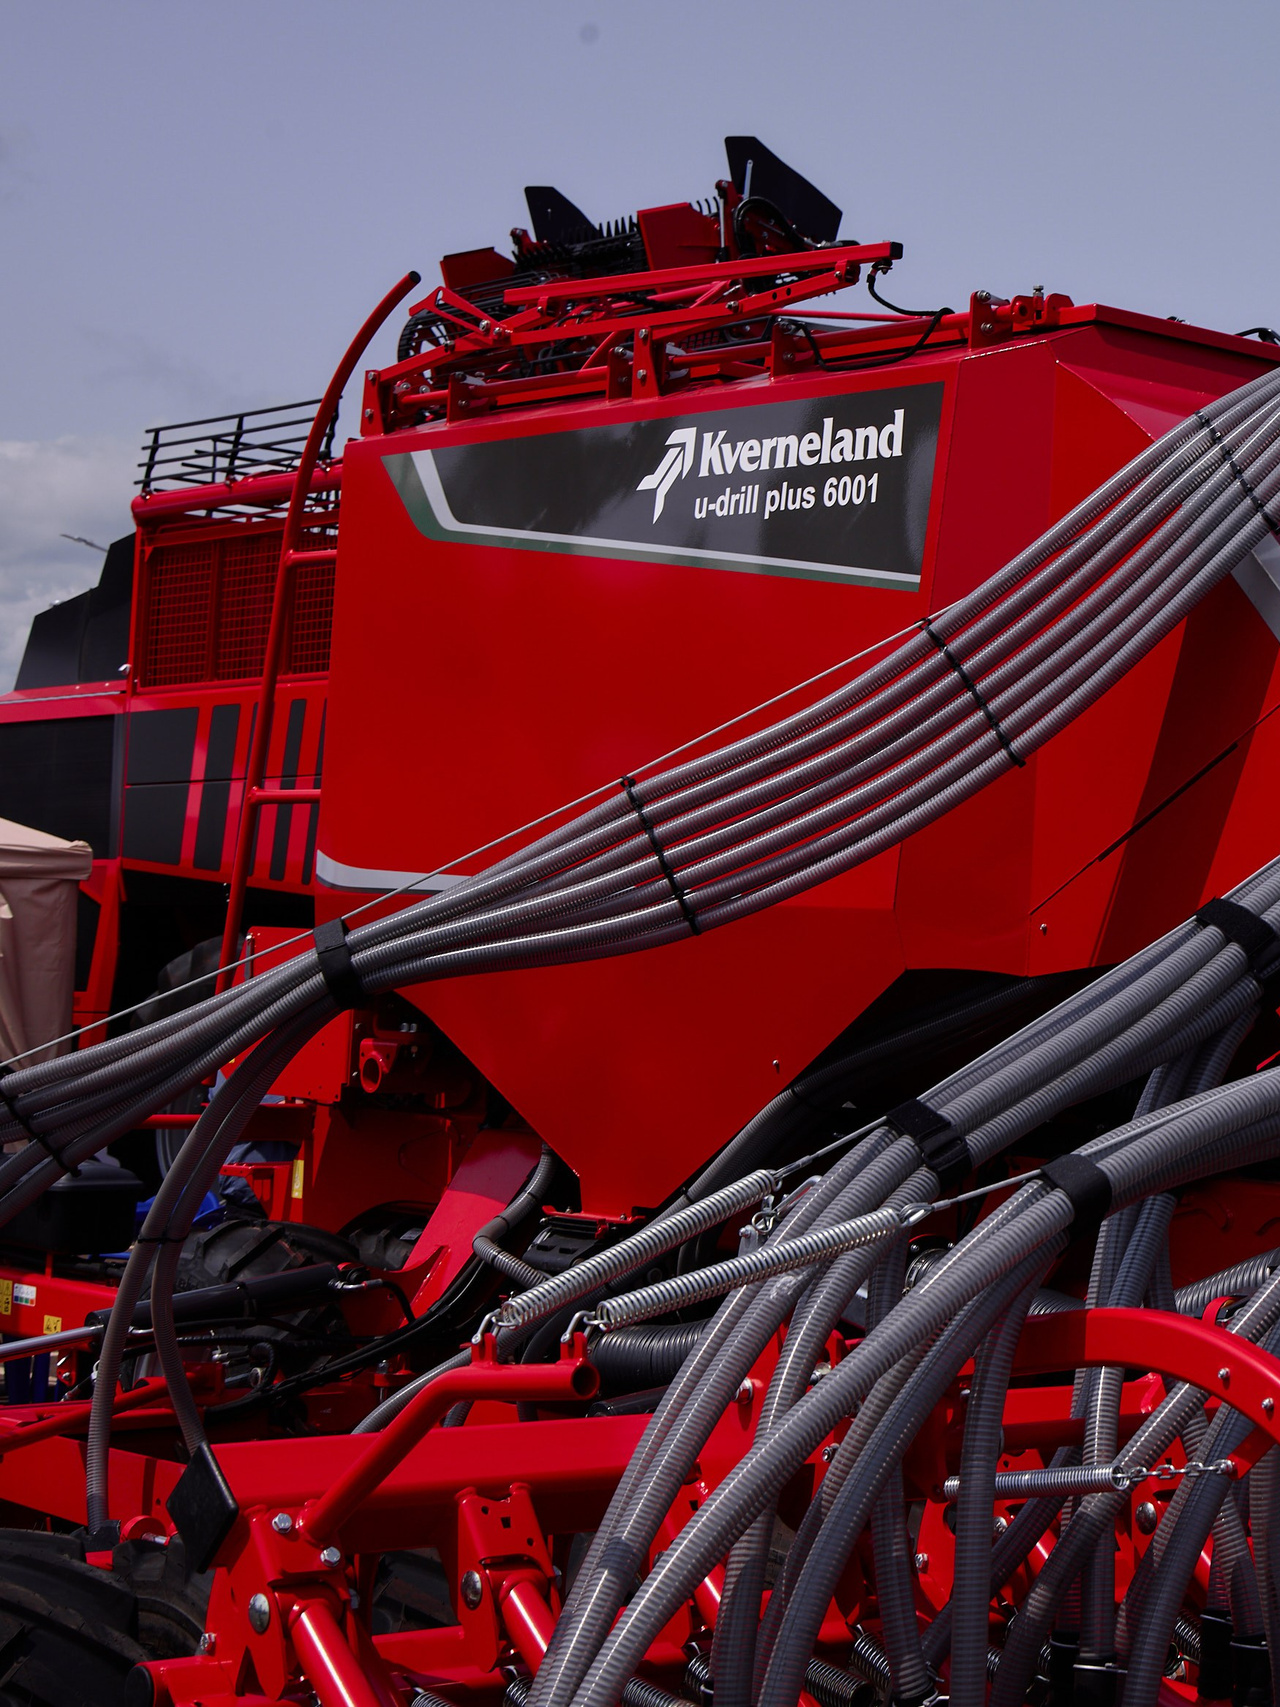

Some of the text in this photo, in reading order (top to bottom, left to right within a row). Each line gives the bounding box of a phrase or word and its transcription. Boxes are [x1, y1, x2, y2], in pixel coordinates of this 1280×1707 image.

[698, 409, 905, 477] Kverneland
[694, 472, 879, 520] u-drill plus 6001
